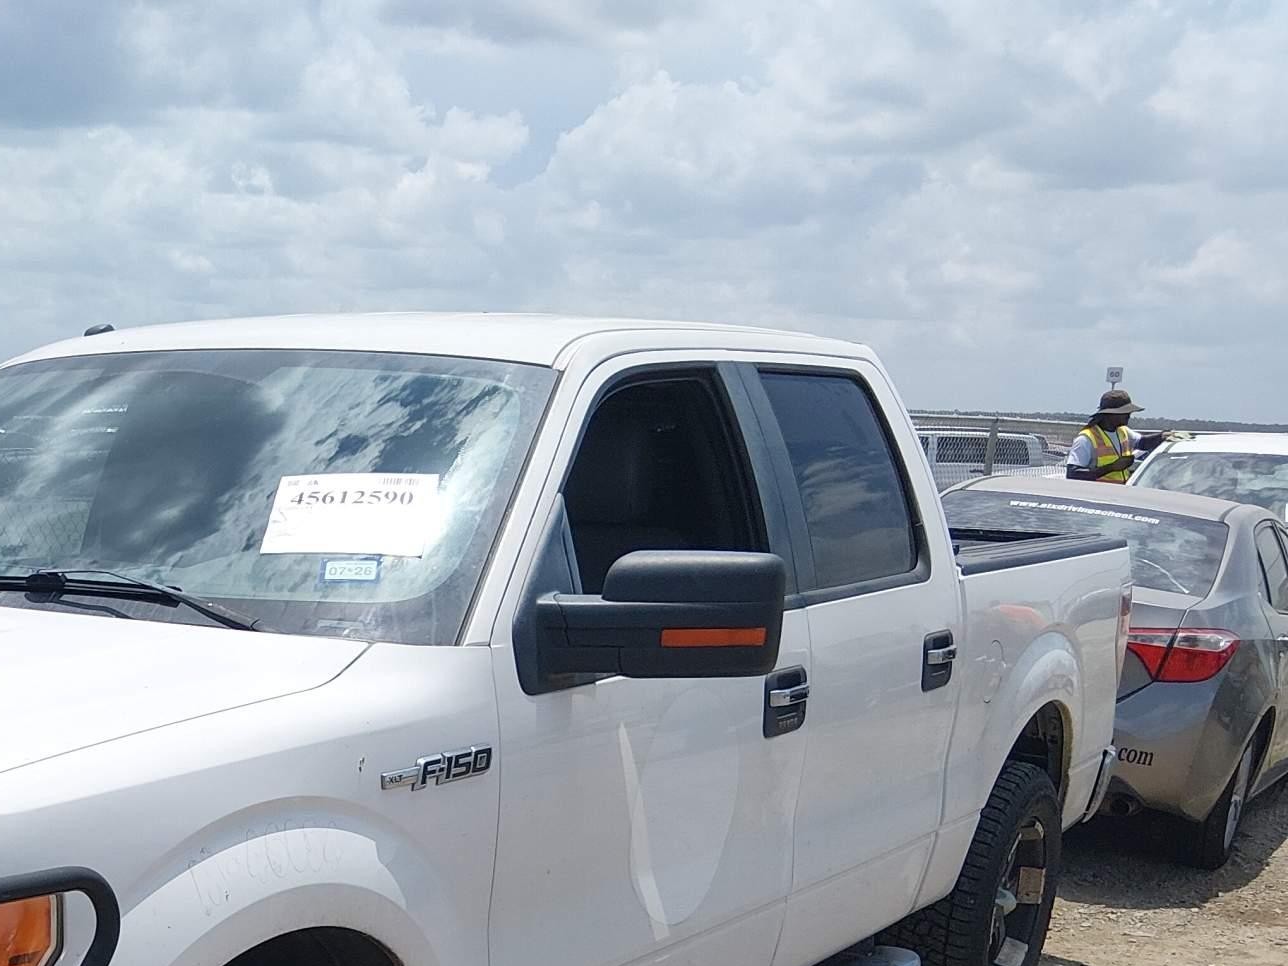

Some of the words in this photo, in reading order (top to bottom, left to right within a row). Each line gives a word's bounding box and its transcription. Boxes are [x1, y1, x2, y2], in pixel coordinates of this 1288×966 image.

[290, 489, 415, 505] 45612590
[388, 774, 404, 784] XLT
[415, 745, 492, 789] F-150
